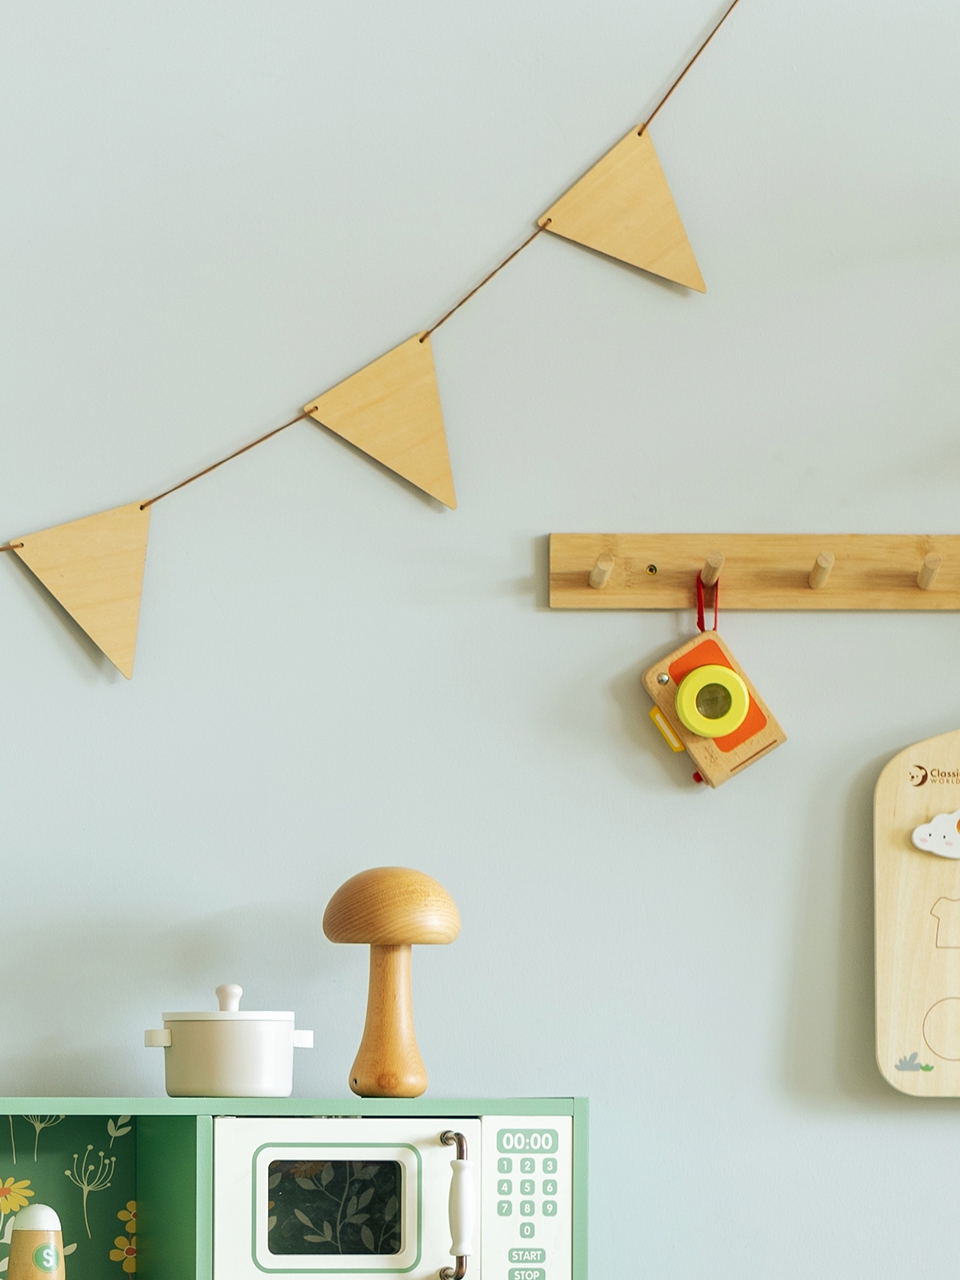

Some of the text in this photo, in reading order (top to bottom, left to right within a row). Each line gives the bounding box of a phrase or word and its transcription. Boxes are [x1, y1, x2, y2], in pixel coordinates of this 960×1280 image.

[930, 768, 960, 778] Classi
[502, 1133, 553, 1150] 00:00
[502, 1160, 553, 1171] 1 2 3
[502, 1182, 553, 1193] 4 5 6
[502, 1203, 553, 1214] 7 8 9
[524, 1225, 531, 1236] 0
[42, 1248, 54, 1268] S
[511, 1251, 542, 1261] START
[514, 1270, 540, 1280] STOP
